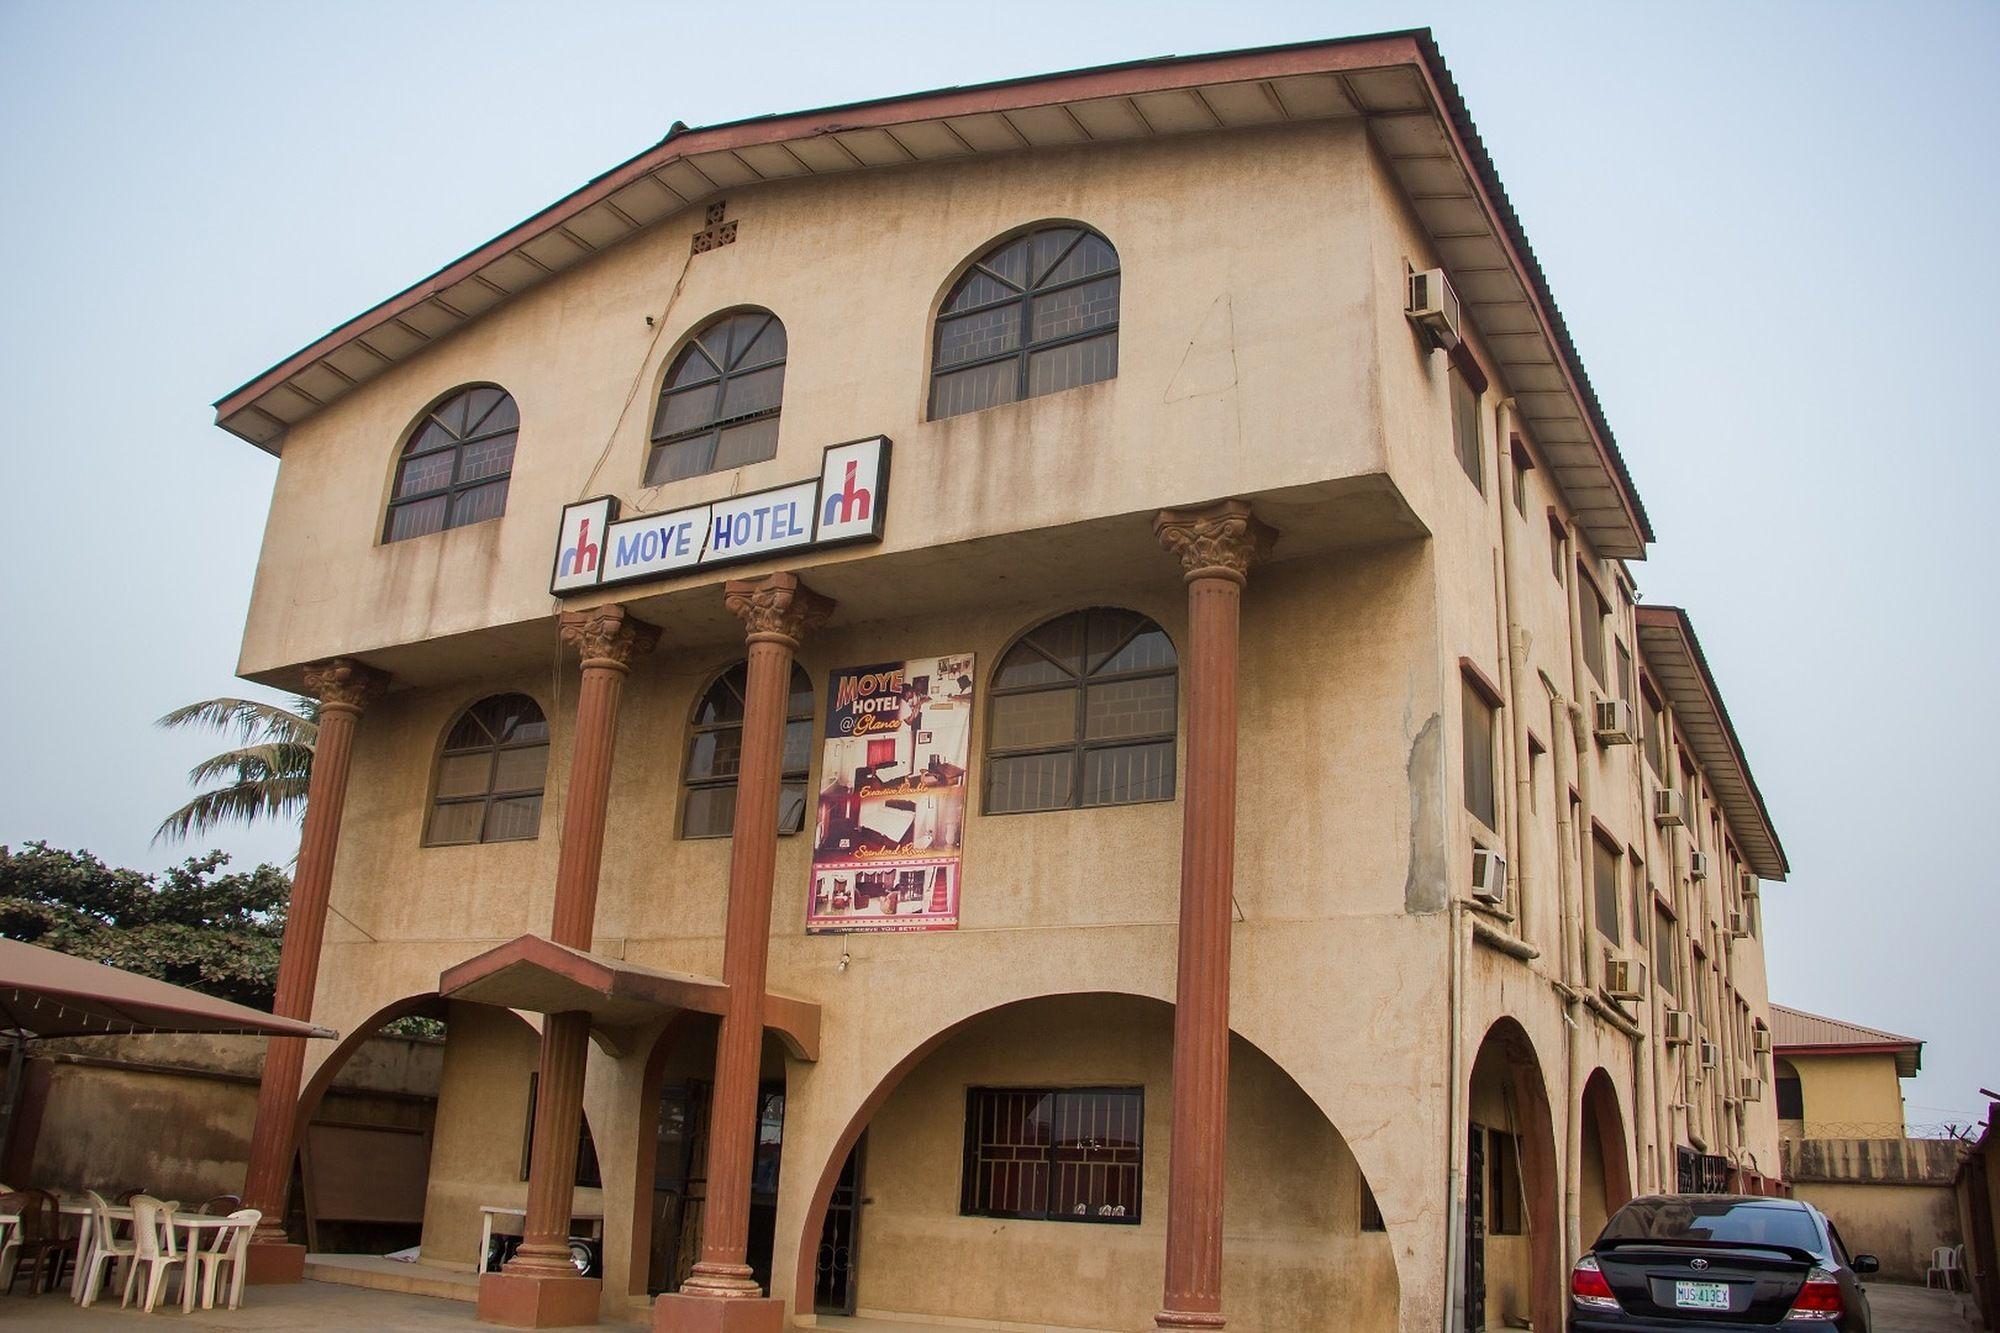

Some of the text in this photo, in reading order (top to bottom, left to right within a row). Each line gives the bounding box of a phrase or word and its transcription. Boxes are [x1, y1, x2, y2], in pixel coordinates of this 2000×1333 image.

[615, 501, 804, 568] MOYE HOTEL
[835, 669, 904, 712] MOYE
[852, 696, 899, 714] HOTEL
[853, 713, 902, 737] Glance
